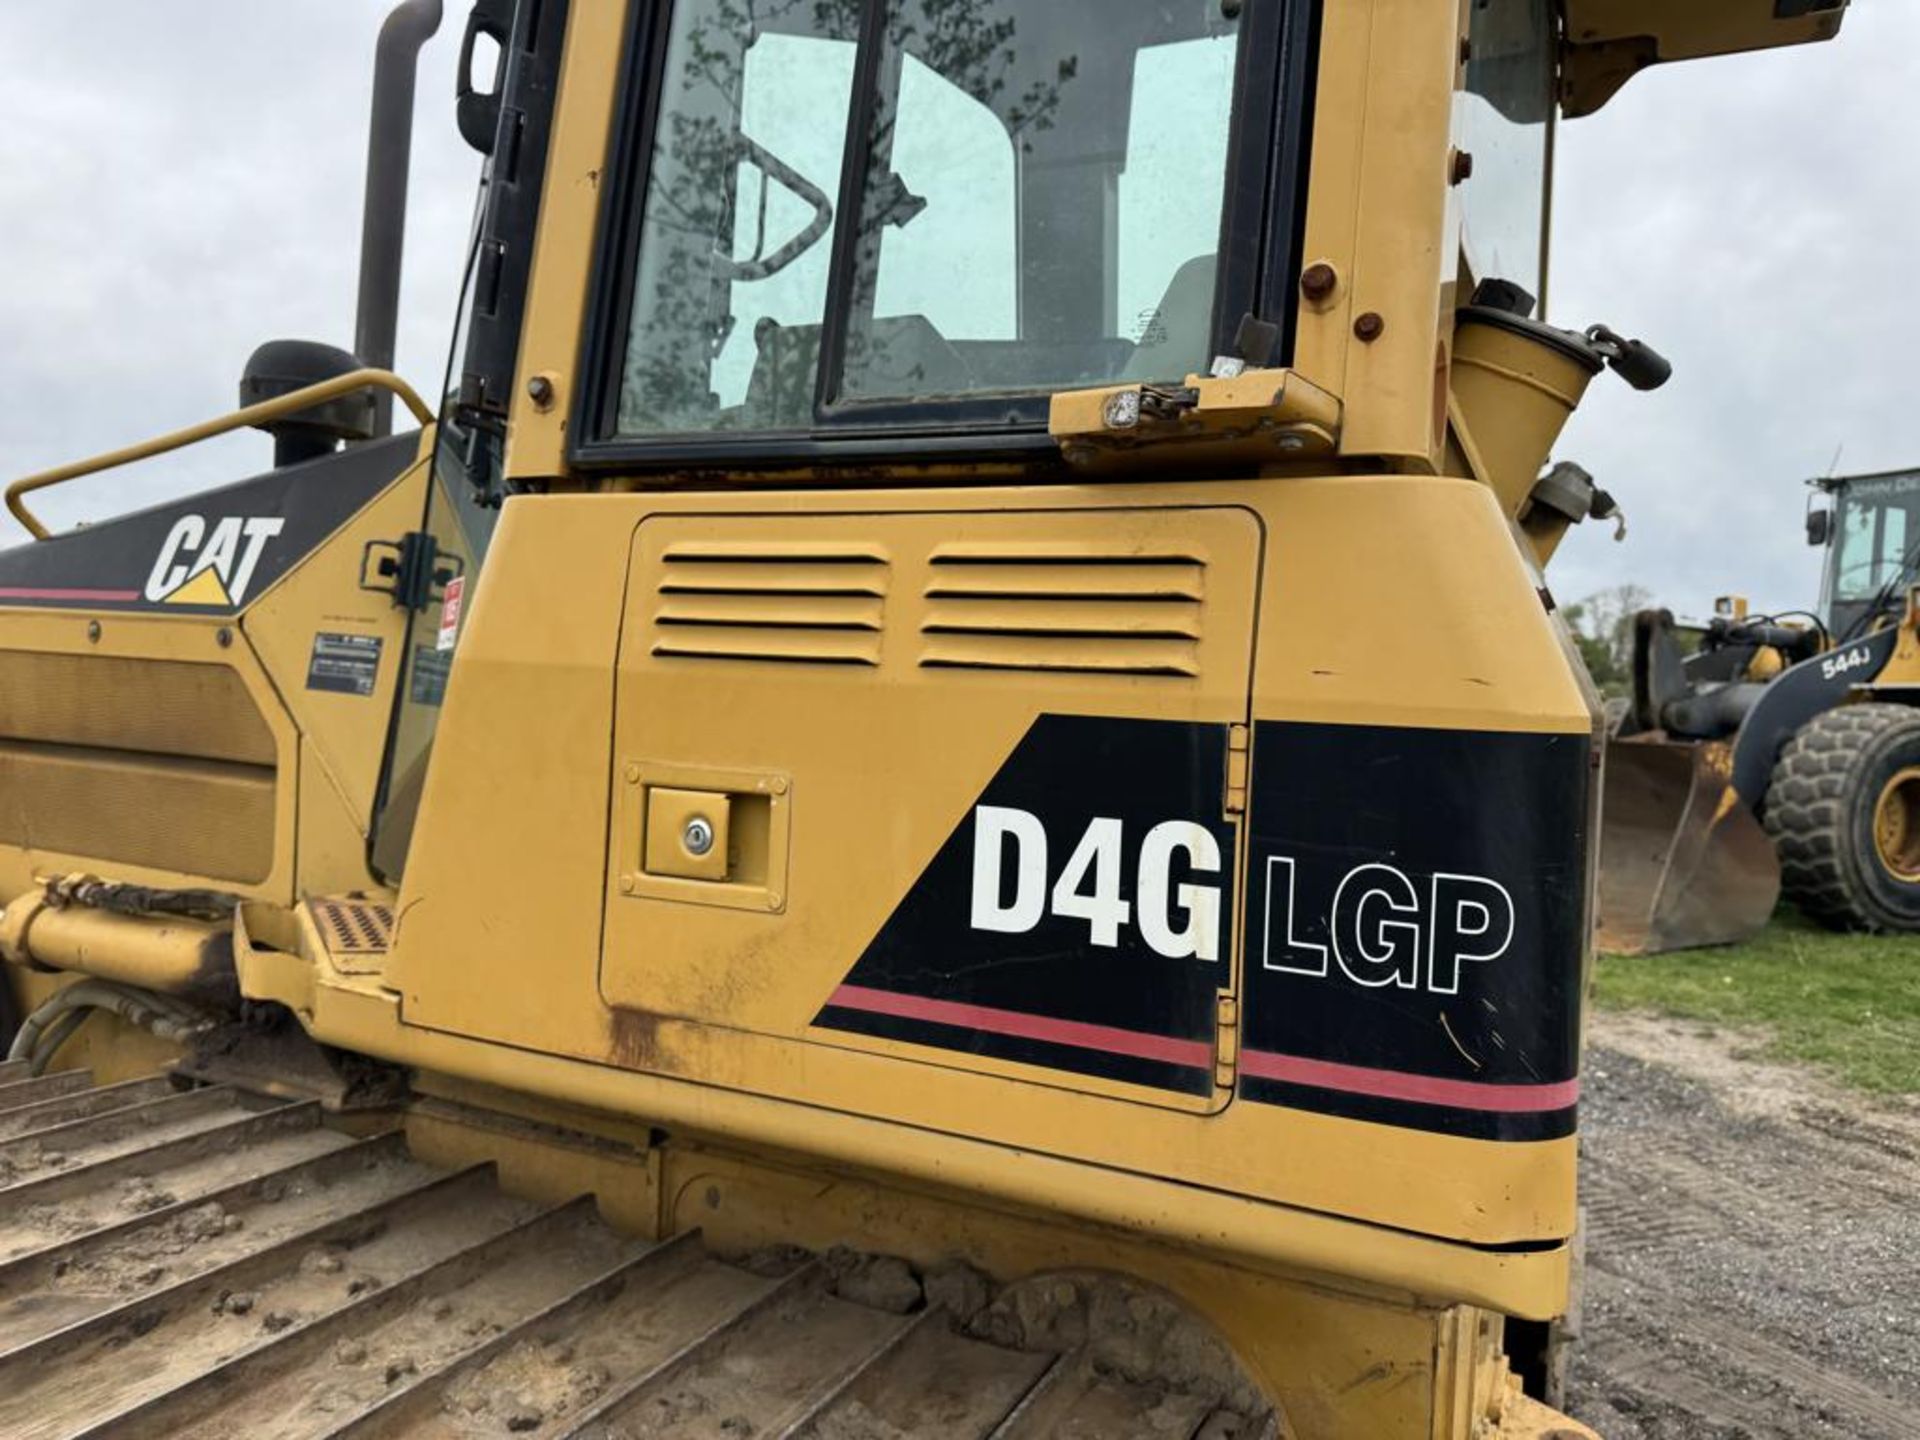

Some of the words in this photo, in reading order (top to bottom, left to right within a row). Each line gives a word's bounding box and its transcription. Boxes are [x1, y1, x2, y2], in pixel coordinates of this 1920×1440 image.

[145, 514, 285, 606] CAT
[1822, 646, 1870, 679] 544J
[970, 804, 1221, 961] D4G
[1263, 855, 1515, 995] LGP
